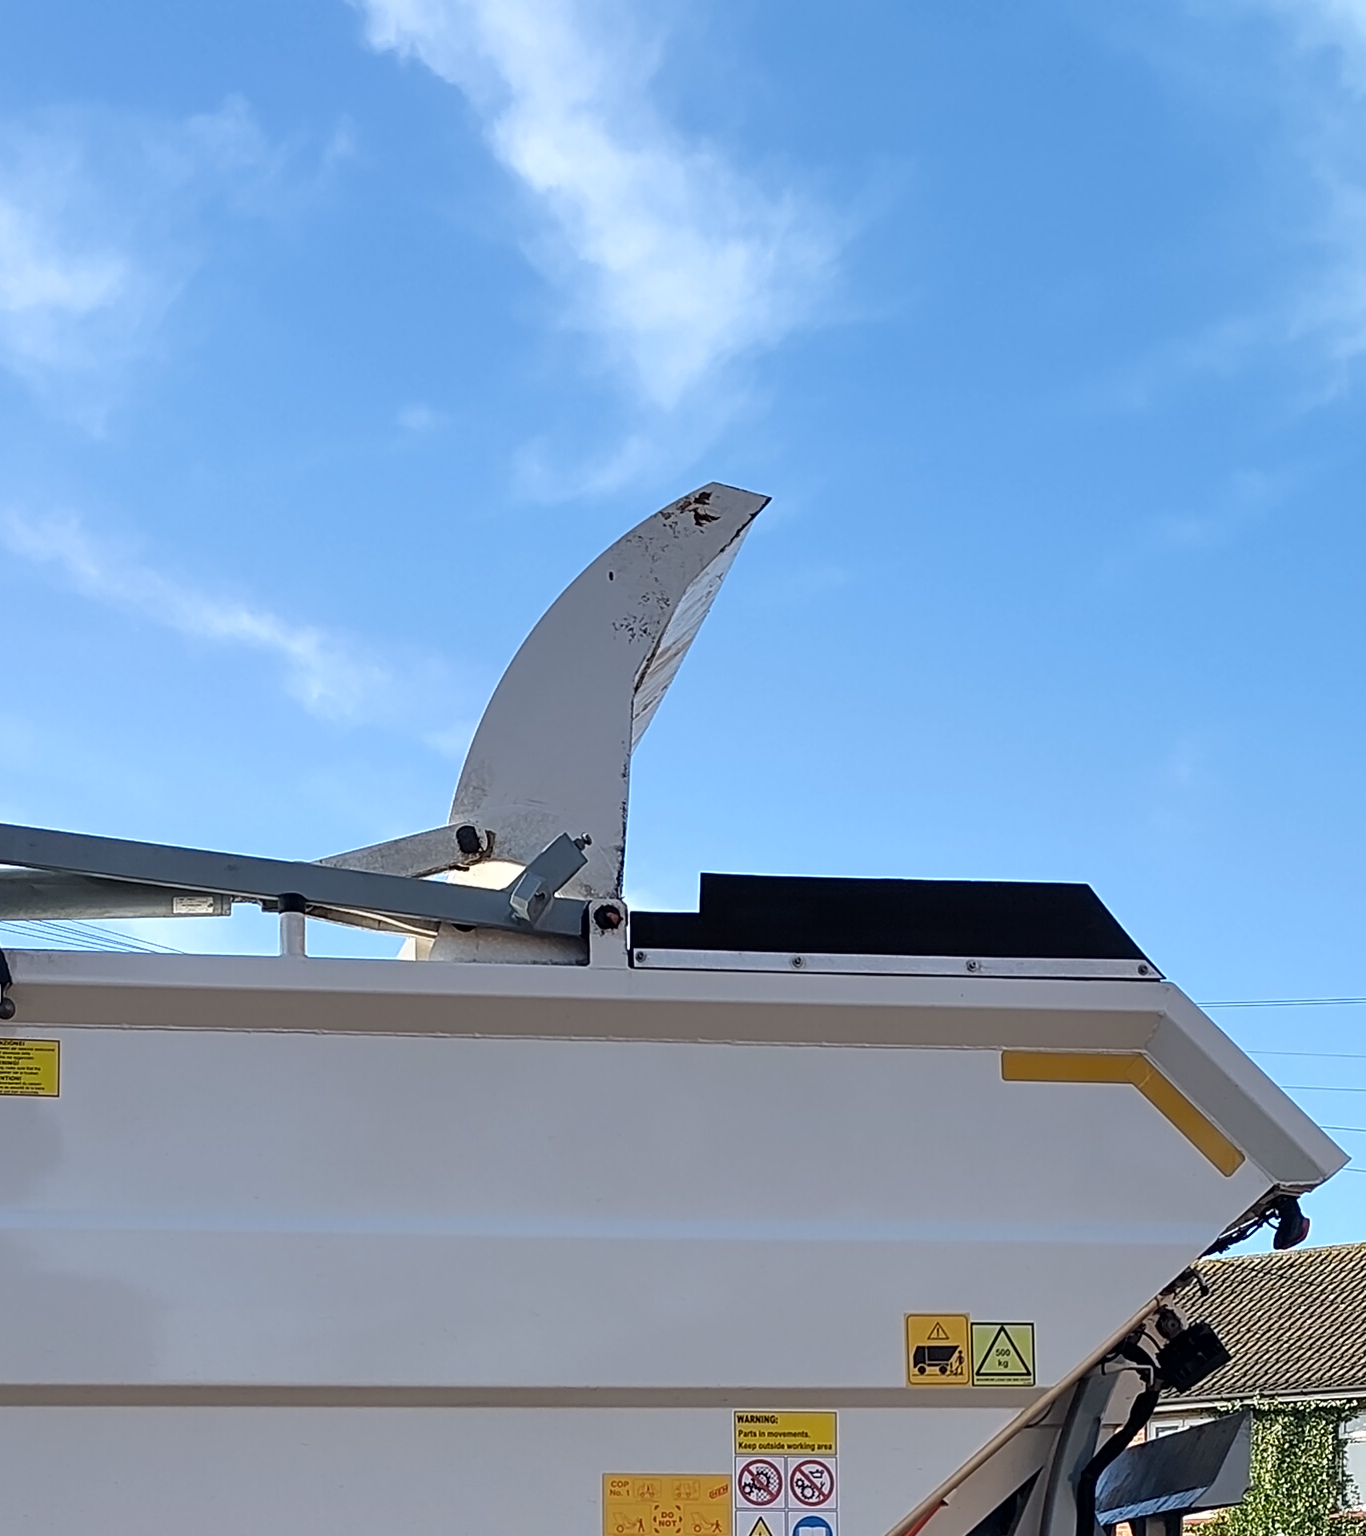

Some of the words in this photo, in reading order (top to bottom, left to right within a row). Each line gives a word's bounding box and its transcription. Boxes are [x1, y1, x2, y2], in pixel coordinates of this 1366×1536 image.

[995, 1348, 1011, 1357] 500
[997, 1358, 1009, 1368] kg
[736, 1414, 779, 1424] WARNING:
[738, 1430, 757, 1438] Parts
[758, 1430, 766, 1438] in
[738, 1442, 756, 1450] Keep
[758, 1442, 785, 1450] outside
[786, 1442, 816, 1452] working
